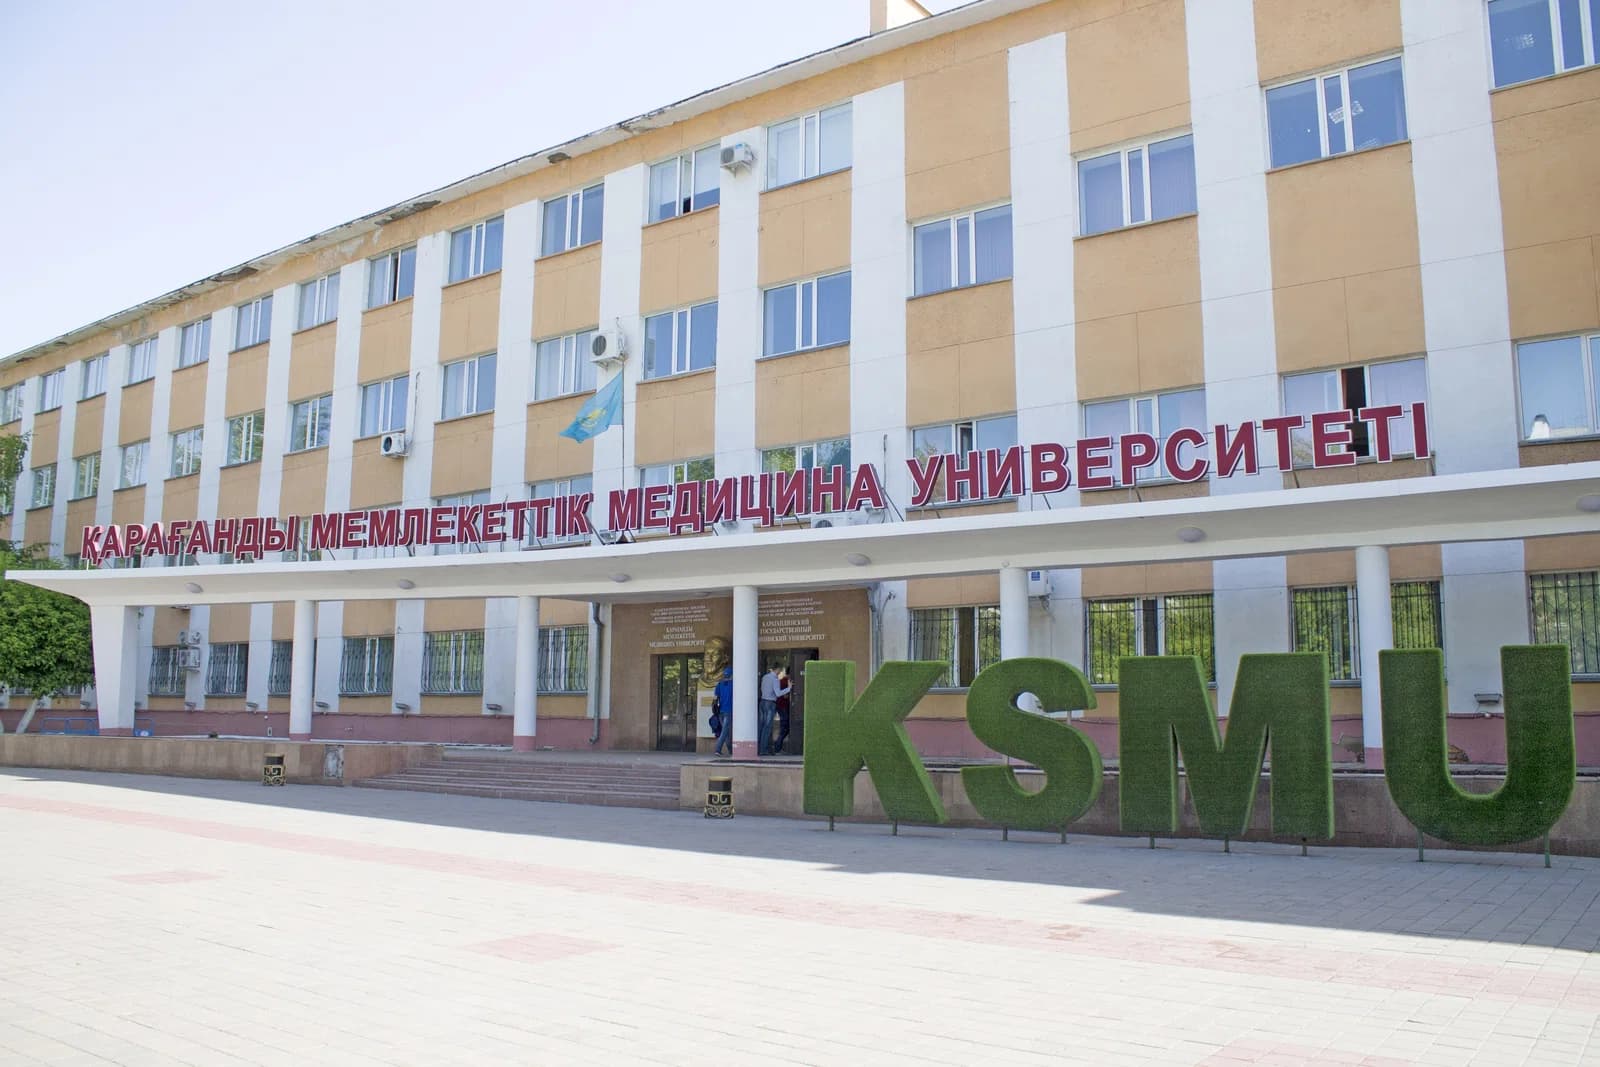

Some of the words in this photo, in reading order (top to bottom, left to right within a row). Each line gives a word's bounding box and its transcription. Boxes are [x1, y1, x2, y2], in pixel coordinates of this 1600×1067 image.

[81, 514, 300, 566] ҚАРАҒАНДЫ
[310, 492, 594, 550] МЕМЛЕКЕТТІК
[607, 463, 887, 536] МЕДИЦИНА
[905, 401, 1432, 507] УНИВЕРСИТЕТІ
[802, 643, 1576, 846] KSMU
